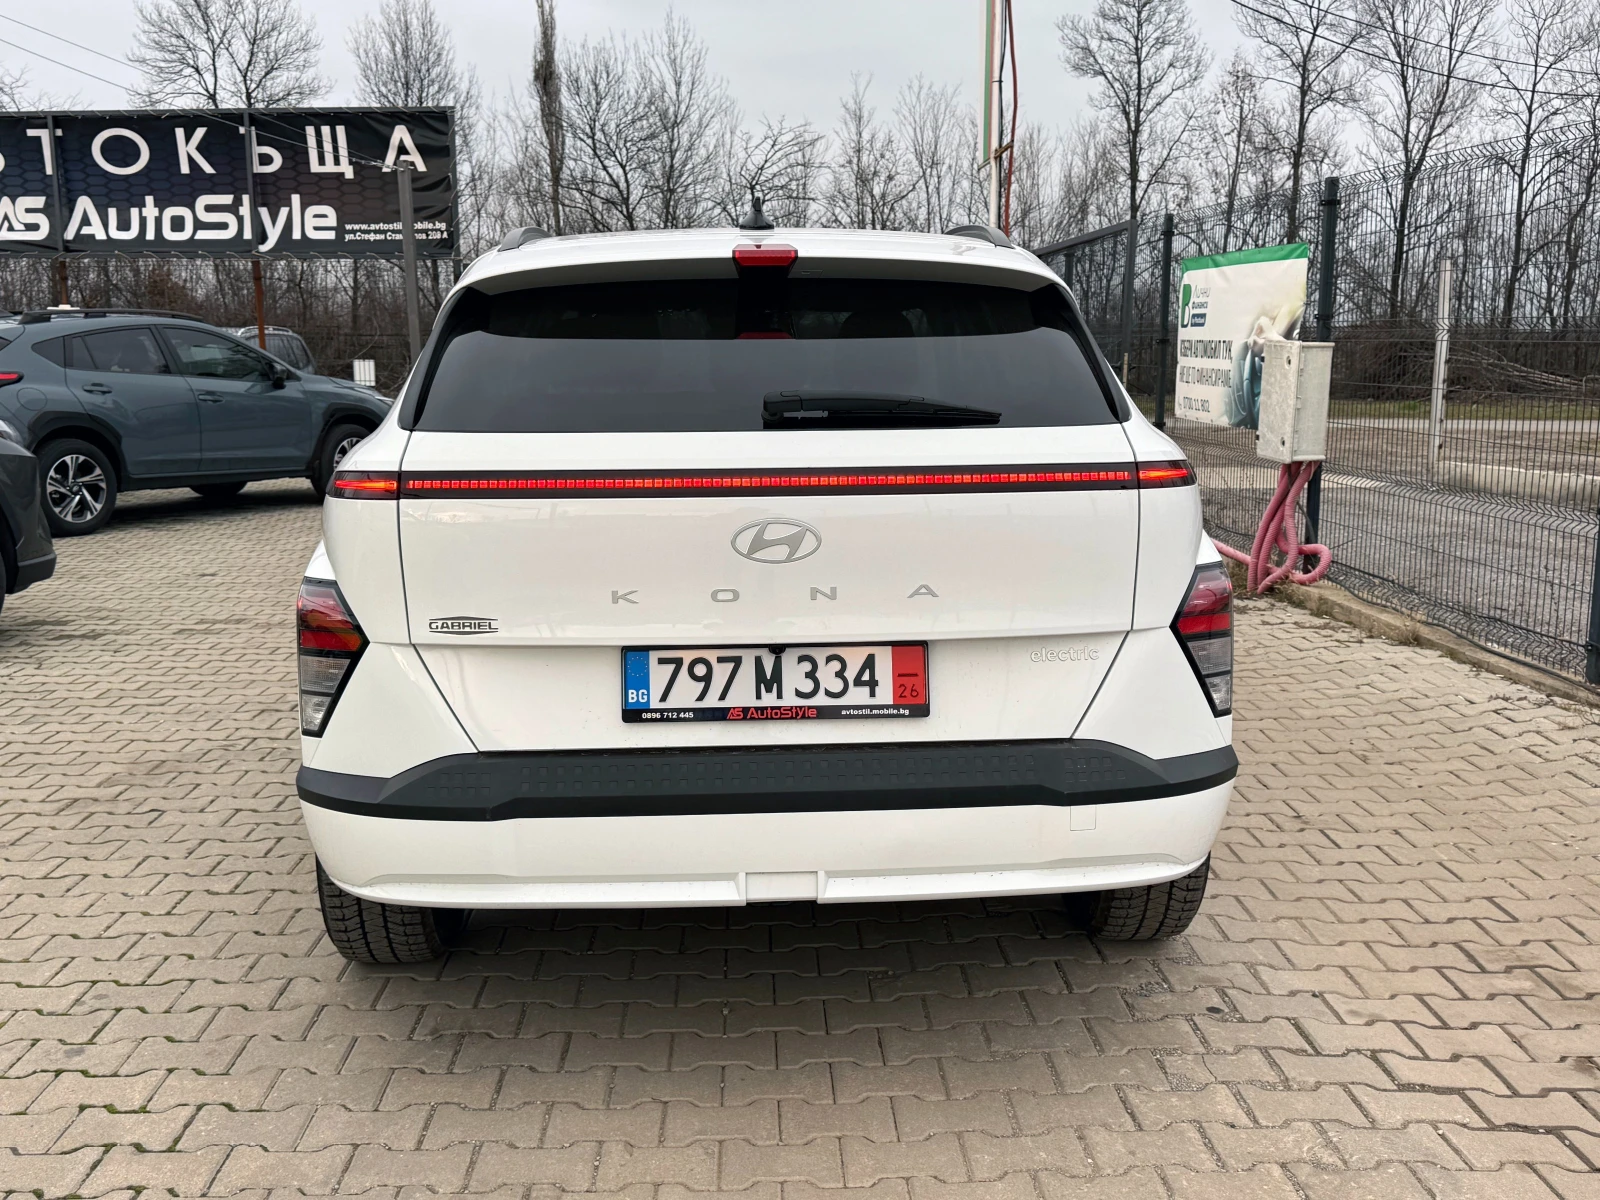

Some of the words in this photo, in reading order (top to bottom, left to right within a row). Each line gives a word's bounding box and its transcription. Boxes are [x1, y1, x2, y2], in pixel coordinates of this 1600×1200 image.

[0, 124, 428, 179] ТОКЪЩА
[63, 194, 338, 253] AutoStyle
[611, 583, 940, 605] KONA
[428, 621, 499, 630] GABRIEL
[1030, 645, 1100, 663] electric
[657, 655, 743, 703] 797
[794, 653, 880, 700] 334
[627, 689, 649, 703] BG
[898, 683, 920, 699] 26
[641, 711, 661, 720] 0896
[663, 711, 678, 719] 712
[679, 711, 694, 719] 445
[747, 706, 817, 720] AutoStyle
[841, 708, 910, 717] avtostil.mobile.bg
